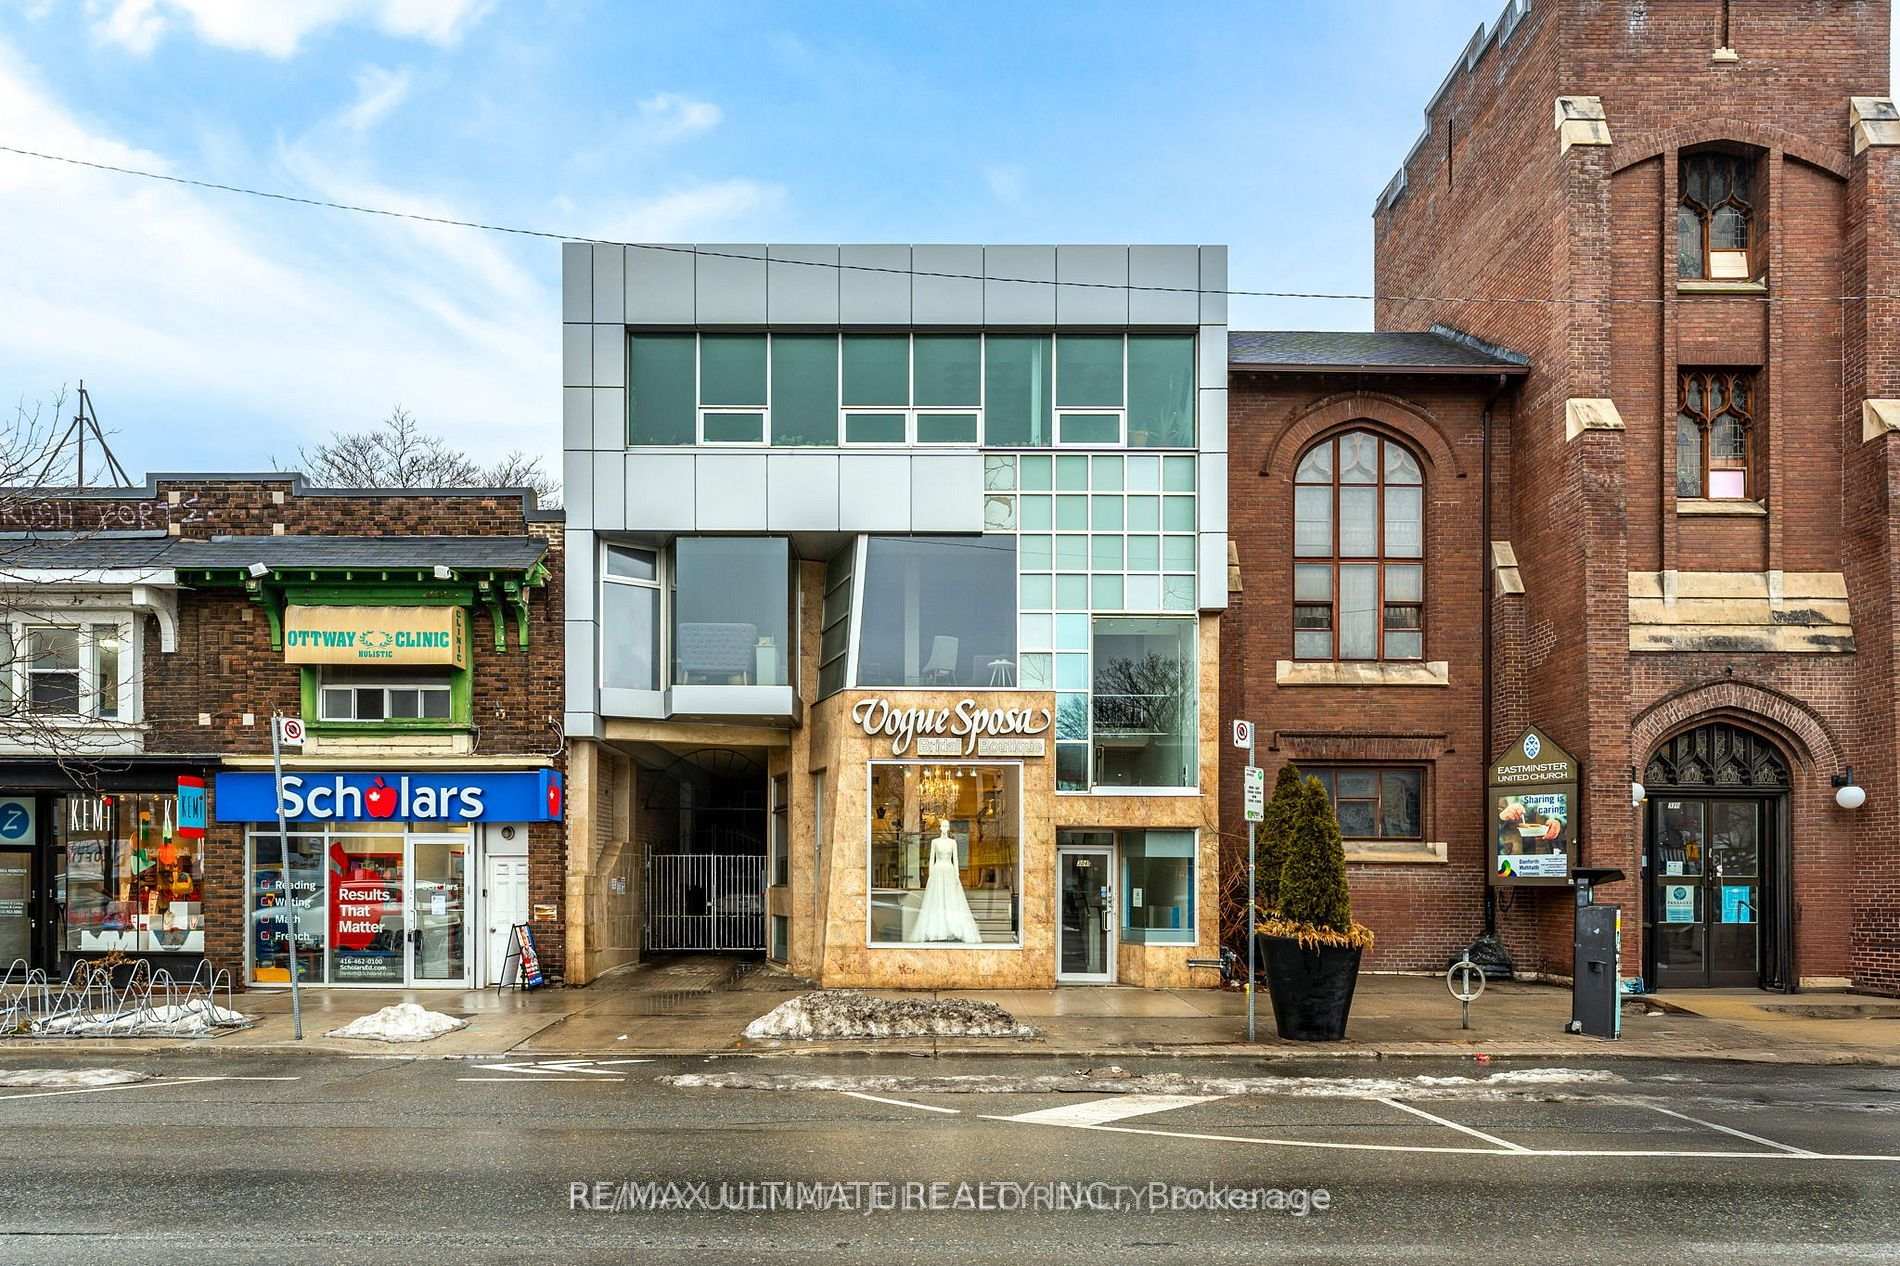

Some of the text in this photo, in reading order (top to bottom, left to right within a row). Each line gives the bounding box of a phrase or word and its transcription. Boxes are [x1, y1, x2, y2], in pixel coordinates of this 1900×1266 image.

[287, 630, 449, 648] OTTWAY CLINIC
[455, 609, 463, 663] CLINIC
[852, 699, 1052, 756] Vogue Sposa
[1497, 762, 1567, 775] EASTMINSTER
[1497, 772, 1568, 783] UNITED CHURCH
[1523, 795, 1565, 805] Sharing is
[1538, 806, 1565, 815] caring
[339, 888, 390, 901] Results
[275, 897, 311, 909] Wting
[339, 904, 371, 917] That
[275, 914, 301, 924] Mah
[339, 920, 385, 933] Matter
